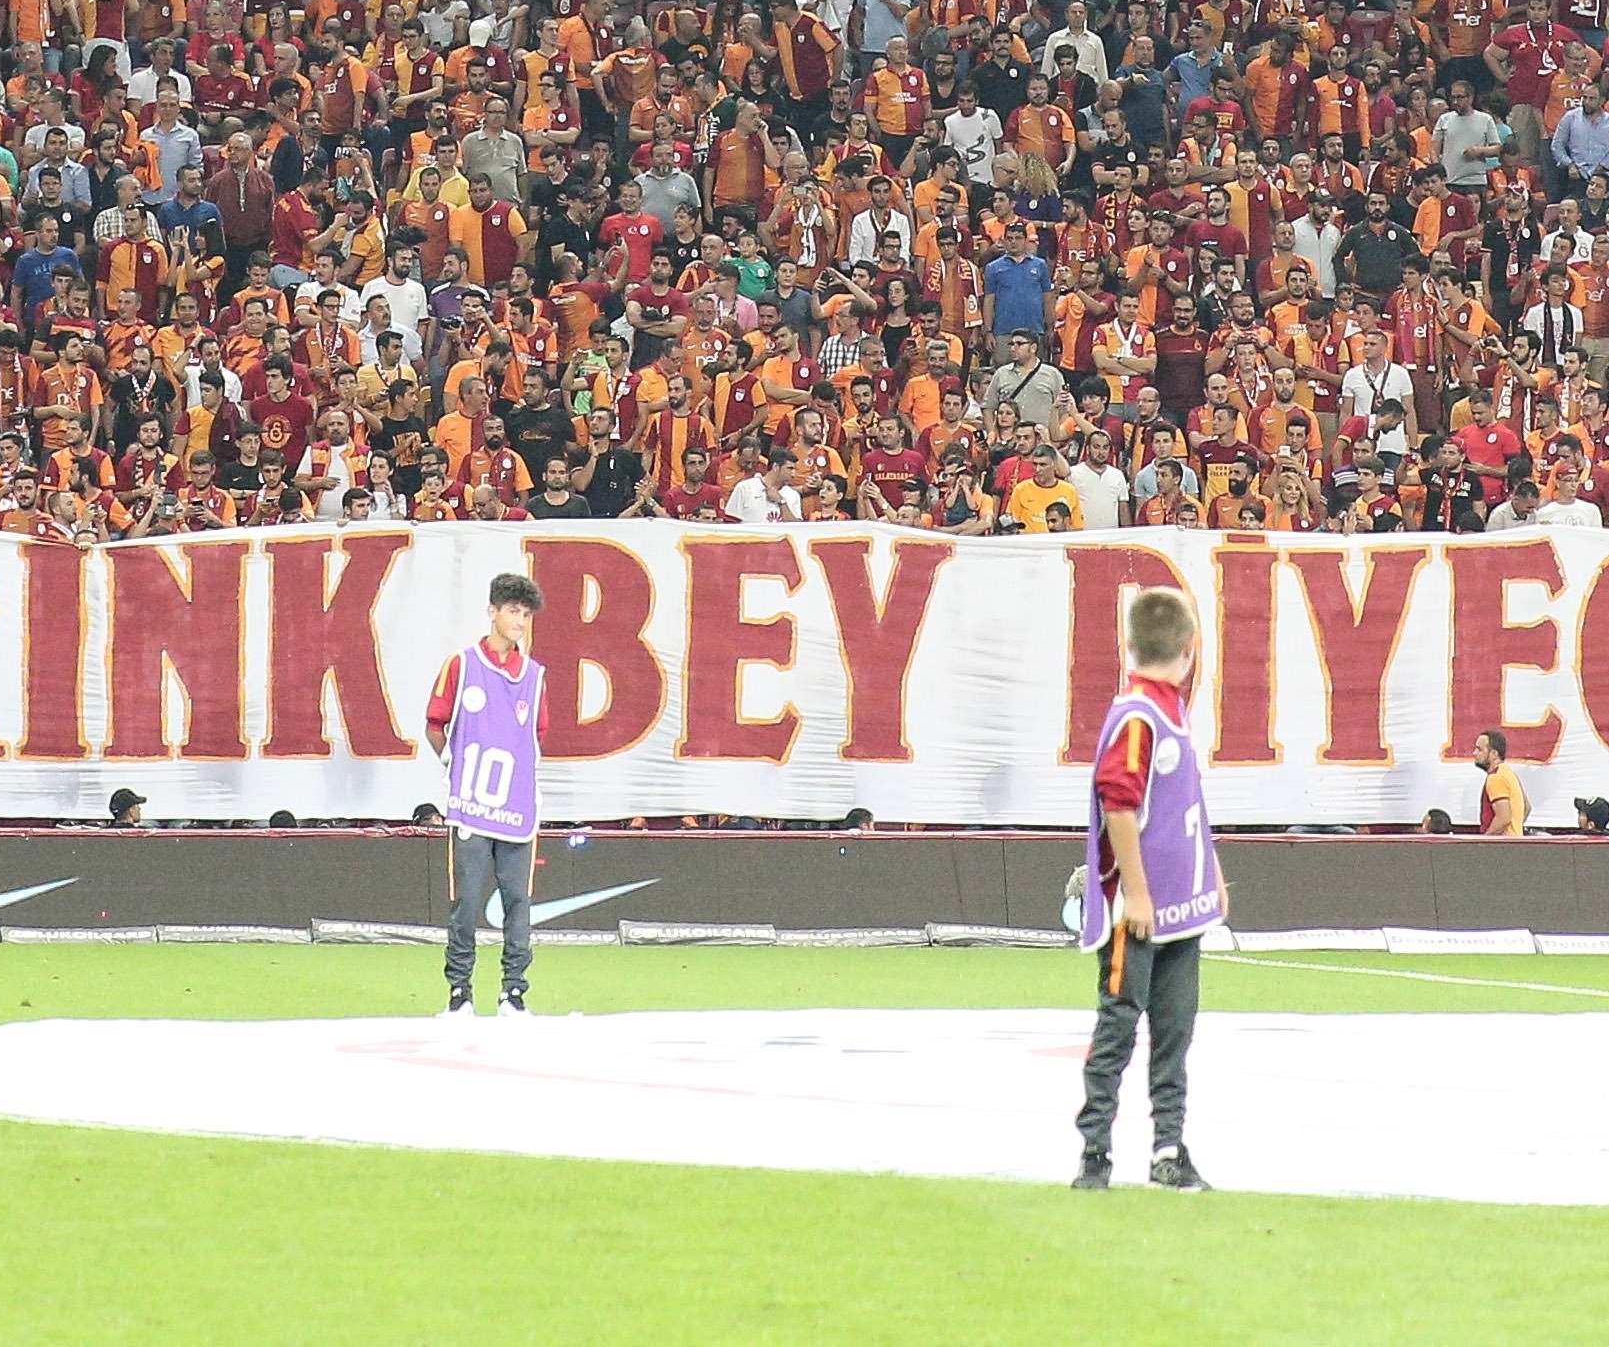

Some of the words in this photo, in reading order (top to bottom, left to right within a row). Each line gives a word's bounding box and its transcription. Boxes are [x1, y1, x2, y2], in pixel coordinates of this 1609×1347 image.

[694, 352, 719, 367] nef
[520, 533, 957, 765] BEY
[458, 741, 515, 810] 10
[1183, 802, 1205, 895] 7
[1155, 898, 1189, 928] TOP
